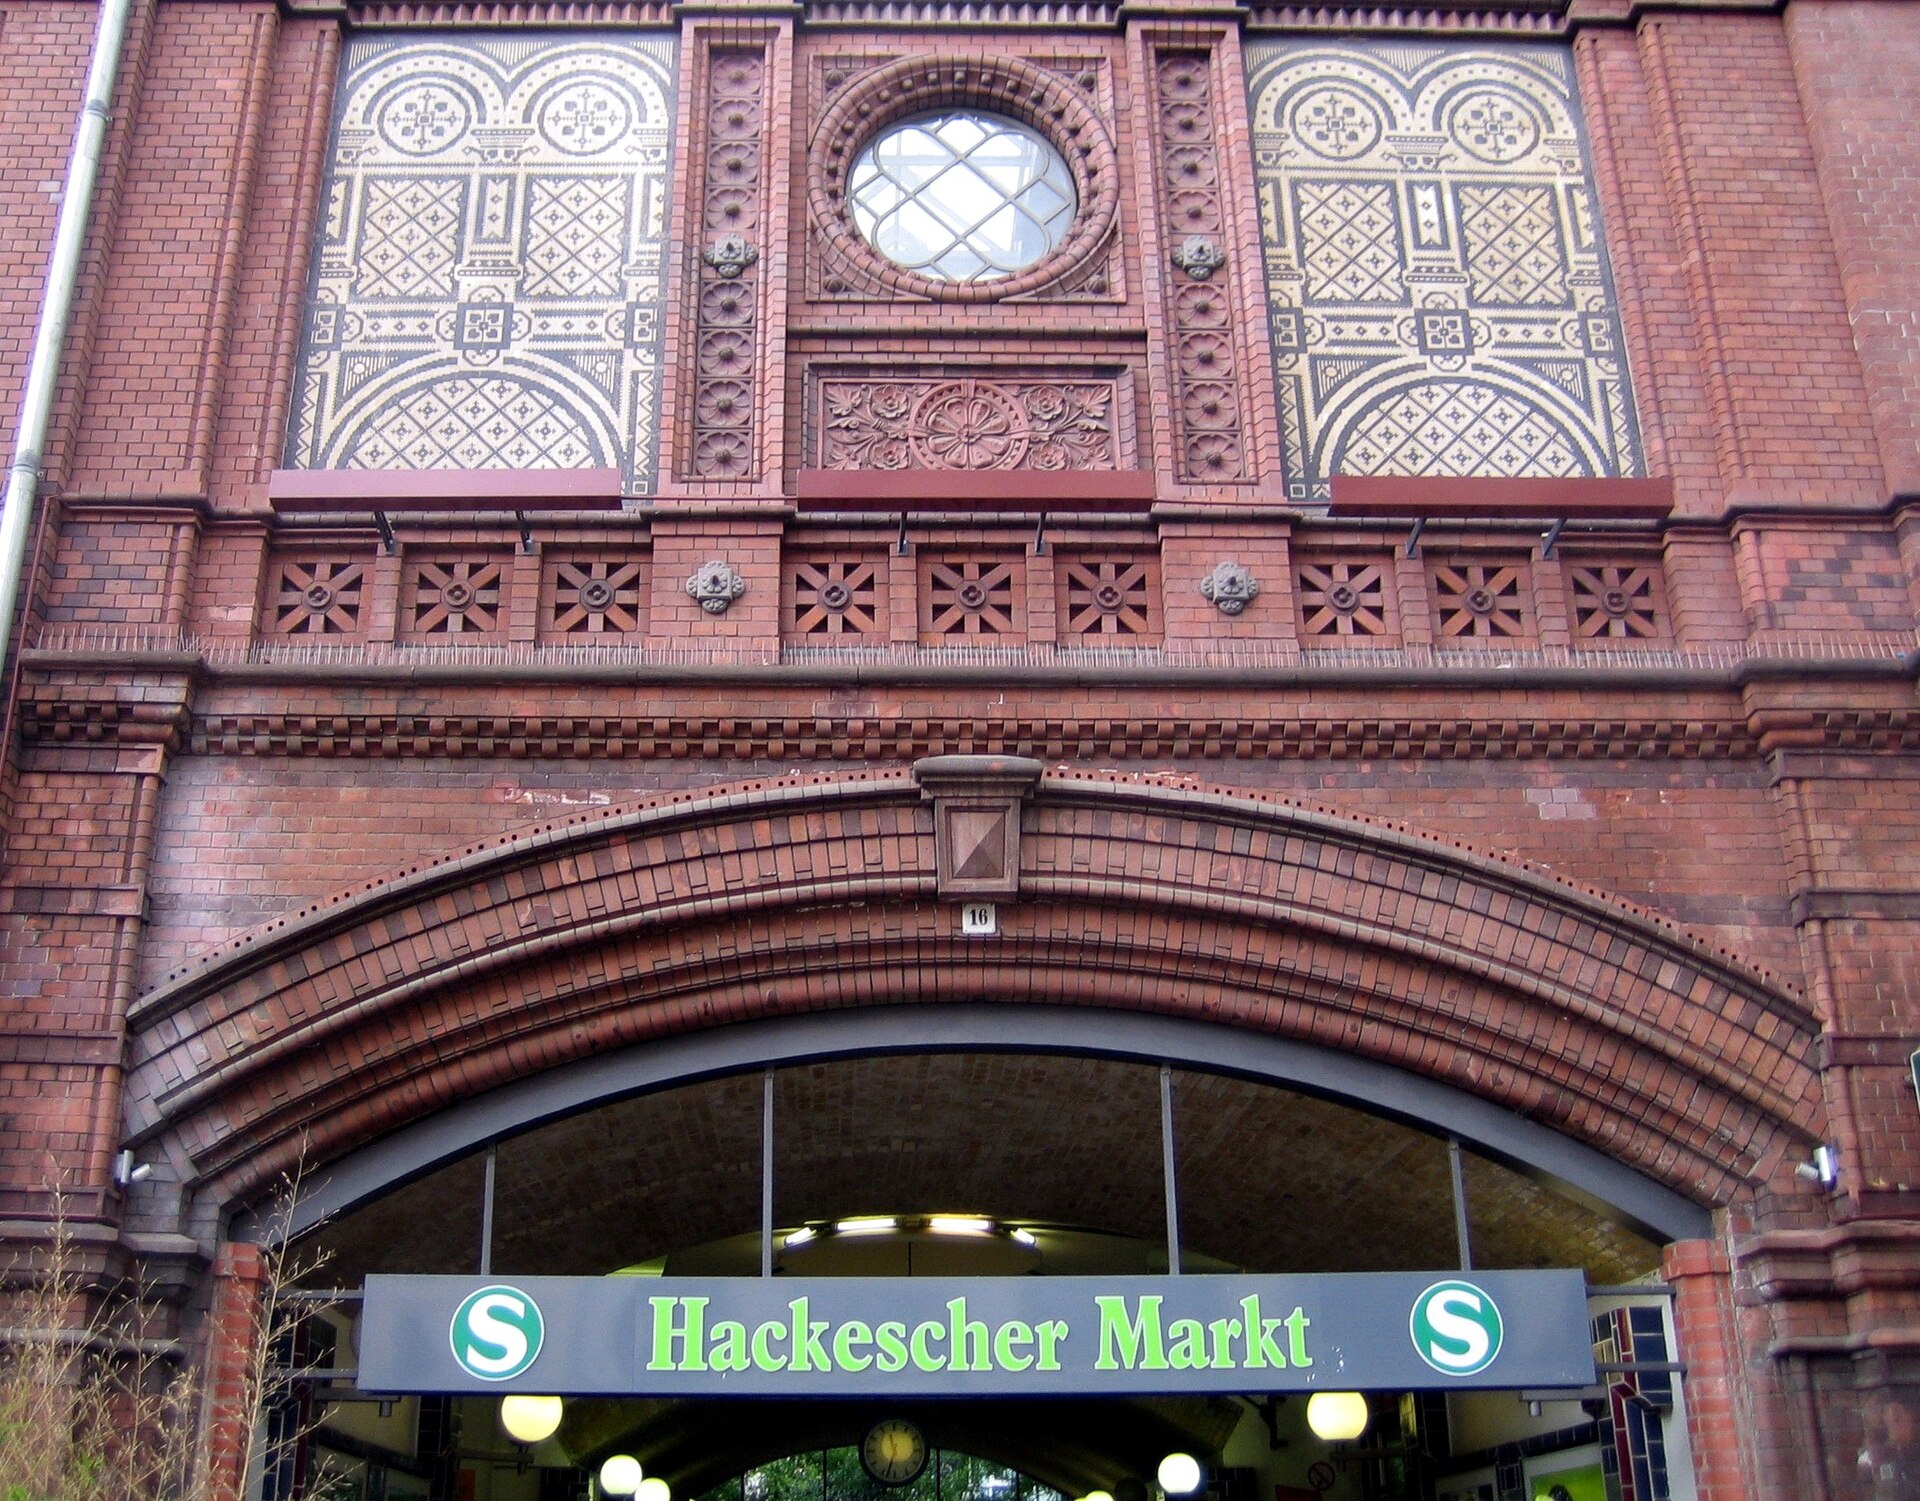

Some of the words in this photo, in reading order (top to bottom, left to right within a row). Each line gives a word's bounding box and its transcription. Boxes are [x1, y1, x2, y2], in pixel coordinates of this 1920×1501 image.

[970, 908, 988, 926] 16
[466, 1294, 528, 1373] S
[646, 1296, 1070, 1373] Hackescher
[1094, 1293, 1313, 1370] Markt
[1426, 1289, 1489, 1367] S
